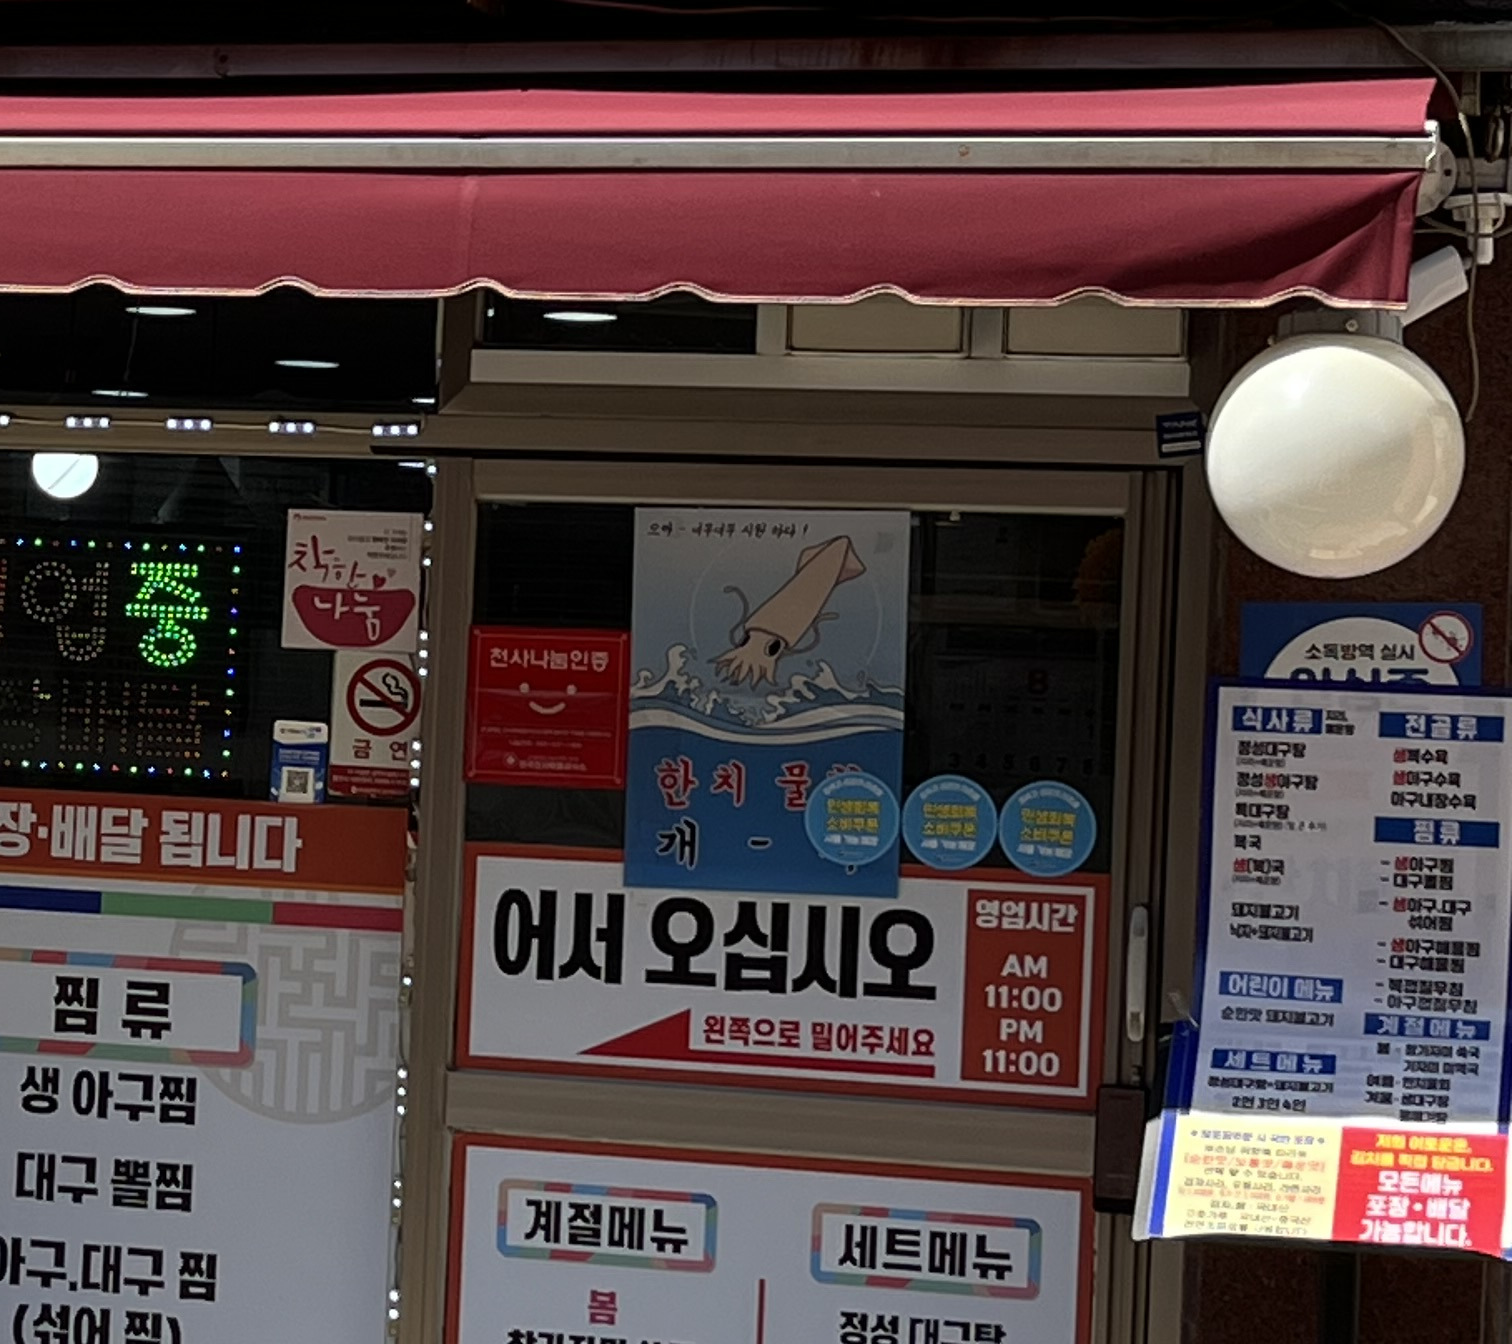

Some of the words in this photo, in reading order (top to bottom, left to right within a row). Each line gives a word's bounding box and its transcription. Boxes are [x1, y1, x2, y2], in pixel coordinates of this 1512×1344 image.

[288, 535, 366, 588] 착한
[313, 592, 381, 641] 나눔
[1304, 643, 1375, 661] 소독방역
[1380, 644, 1415, 661] 실시
[1242, 707, 1314, 733] 식사류
[1405, 713, 1478, 740] 전골류
[655, 755, 746, 809] 한치
[160, 811, 303, 873] 됩니다
[974, 898, 1079, 935] 영업시간
[493, 887, 626, 985] 어서
[644, 897, 936, 1000] 오십시오
[1000, 954, 1049, 979] AM
[984, 984, 1062, 1013] 11:00
[1228, 974, 1289, 999] 어린이
[1294, 978, 1335, 1002] 메뉴
[703, 1014, 800, 1050] 왼쪽으로
[810, 1017, 935, 1057] 밀어주세요
[999, 1018, 1044, 1044] PM
[1377, 1015, 1477, 1039] 계절메뉴
[982, 1047, 1060, 1078] 11:00
[1224, 1050, 1324, 1074] 세트메뉴
[19, 1065, 60, 1114] 생
[72, 1070, 197, 1125] 아구찜
[15, 1152, 98, 1204] 대구
[111, 1158, 193, 1212] 뽈찜
[524, 1197, 689, 1255] 계절메뉴
[838, 1223, 1013, 1280] 세트메뉴
[178, 1250, 217, 1302] 찜
[588, 1288, 618, 1326] 봄
